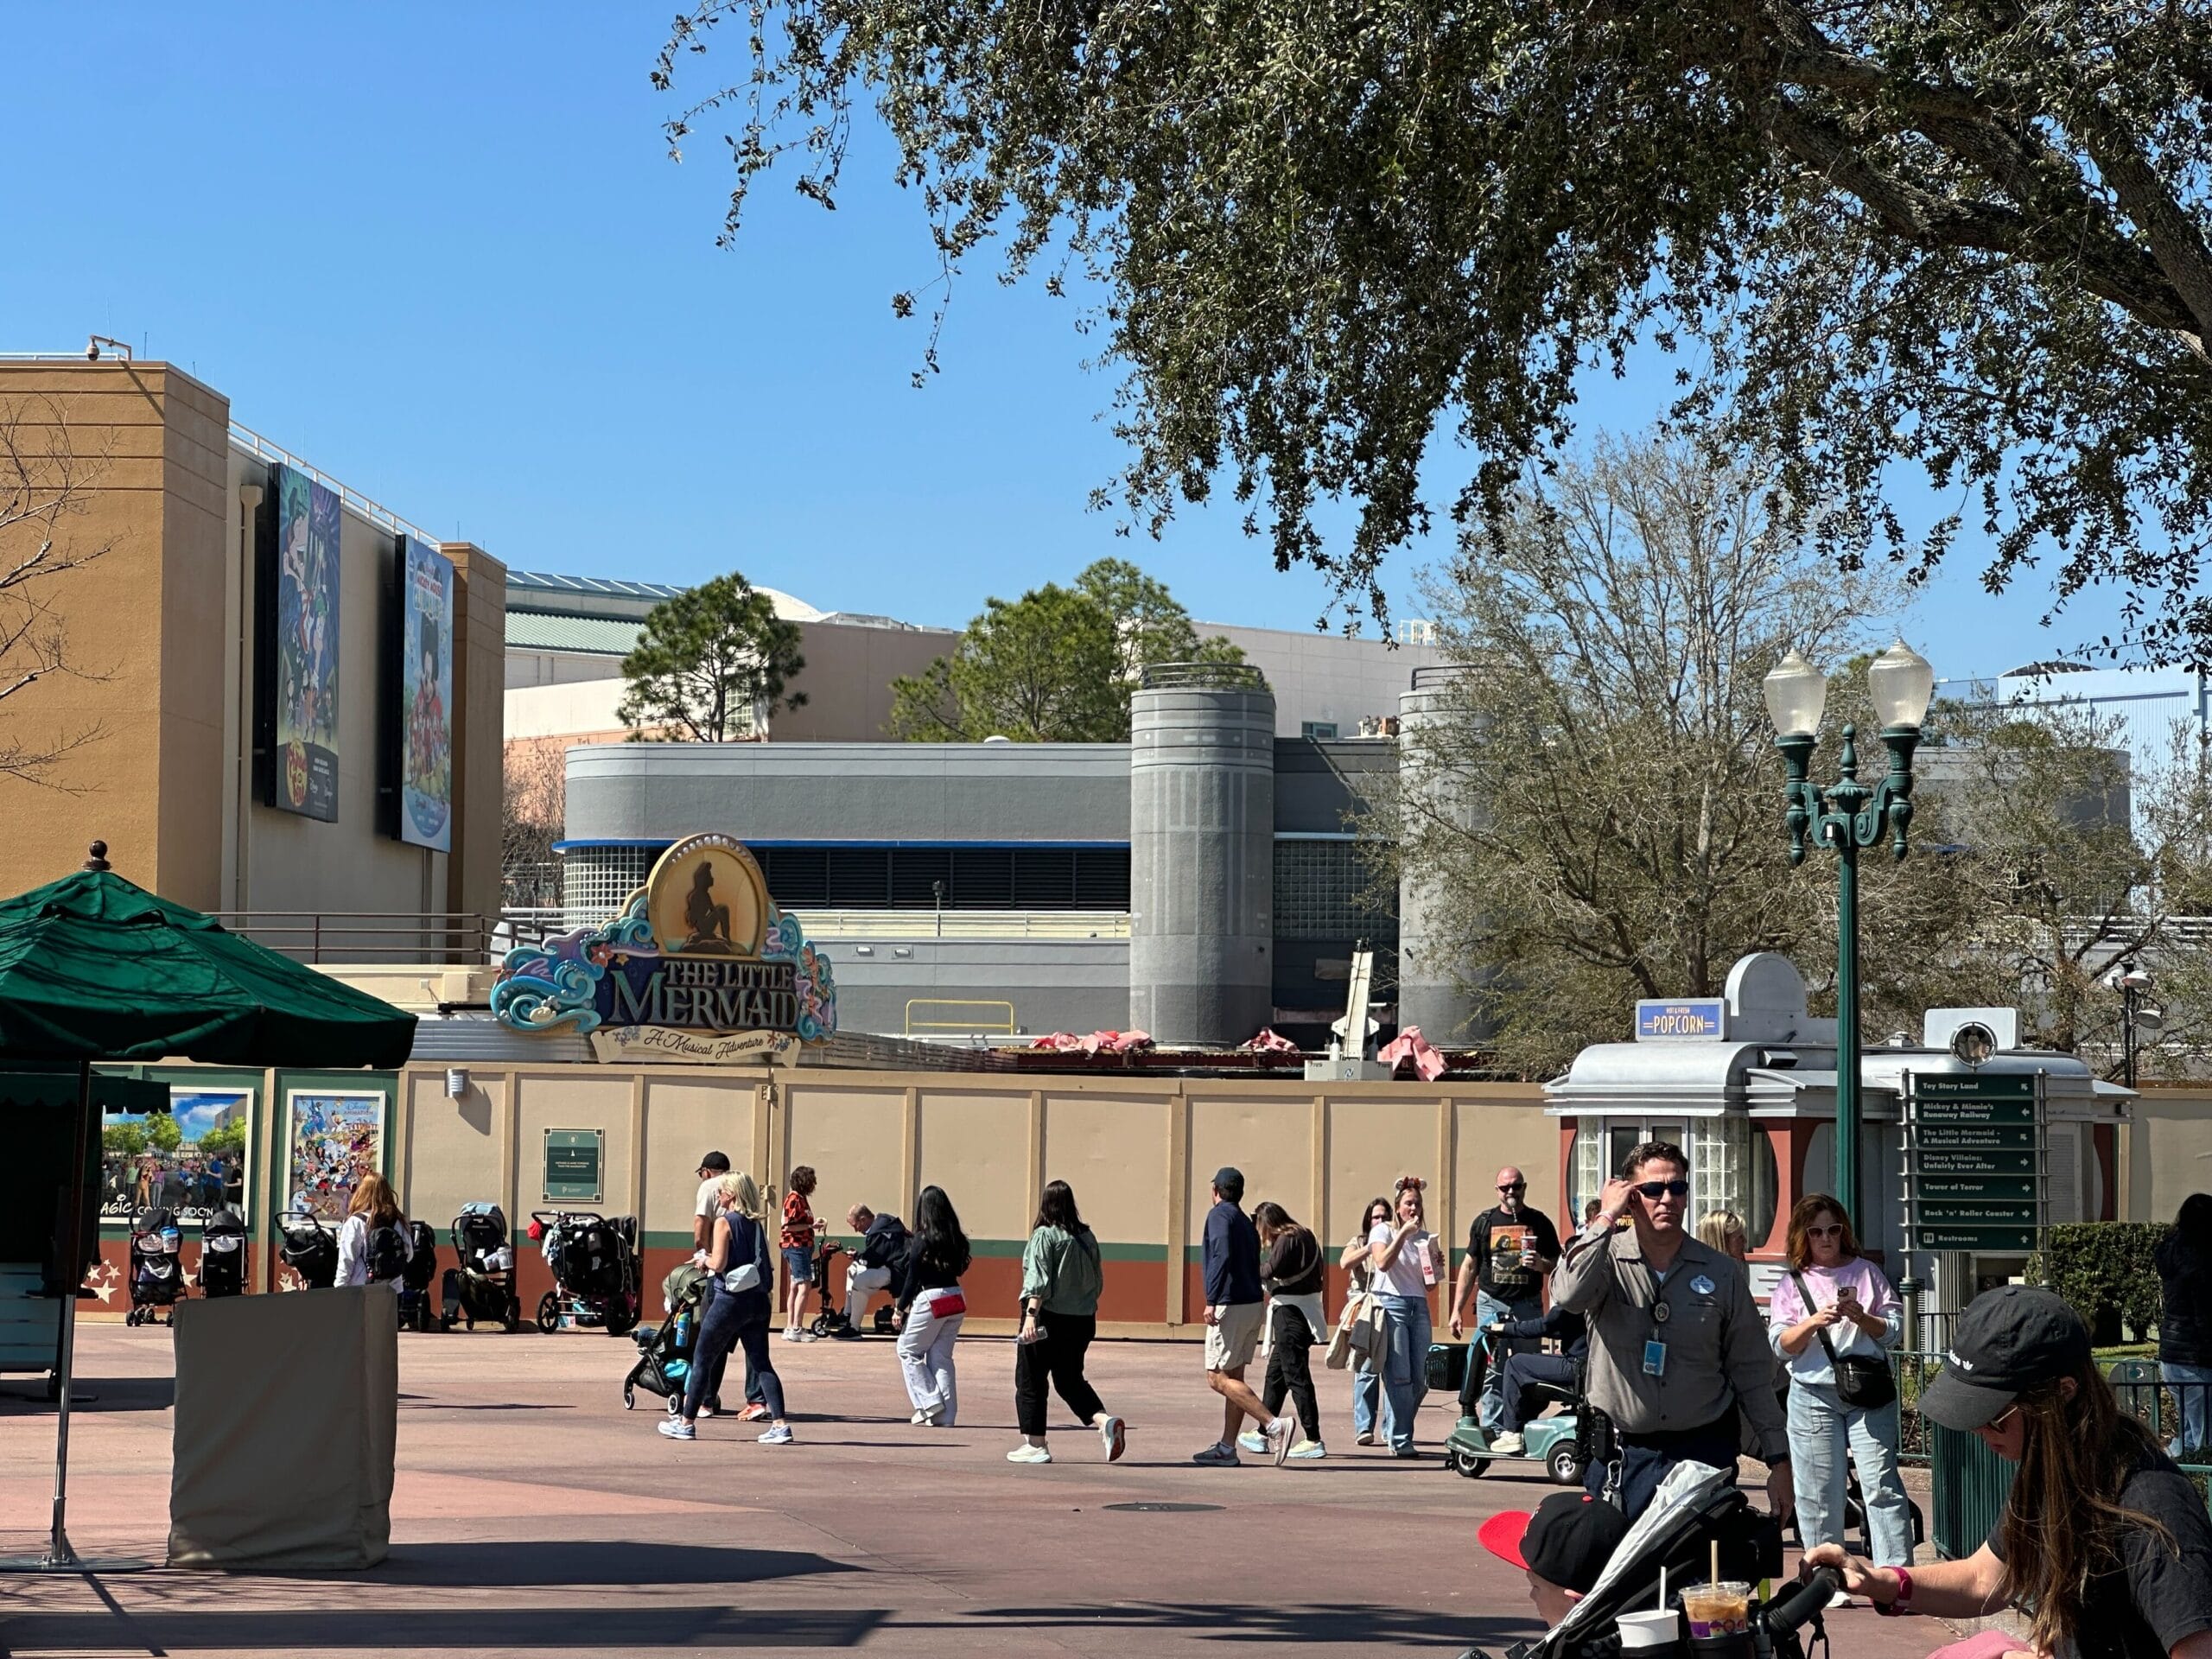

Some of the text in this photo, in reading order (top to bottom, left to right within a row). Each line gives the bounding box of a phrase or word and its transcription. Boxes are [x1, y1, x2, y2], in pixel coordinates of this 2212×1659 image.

[664, 960, 793, 990] THE LITTLE
[607, 969, 798, 1031] MERMAID
[1654, 1015, 1704, 1034] POPCORN
[644, 1028, 764, 1059] A Musical Adventure
[1923, 1103, 1950, 1111] Mickey
[1960, 1111, 1990, 1120] Railway
[100, 1193, 132, 1215] AGIC
[183, 1207, 214, 1217] SOON
